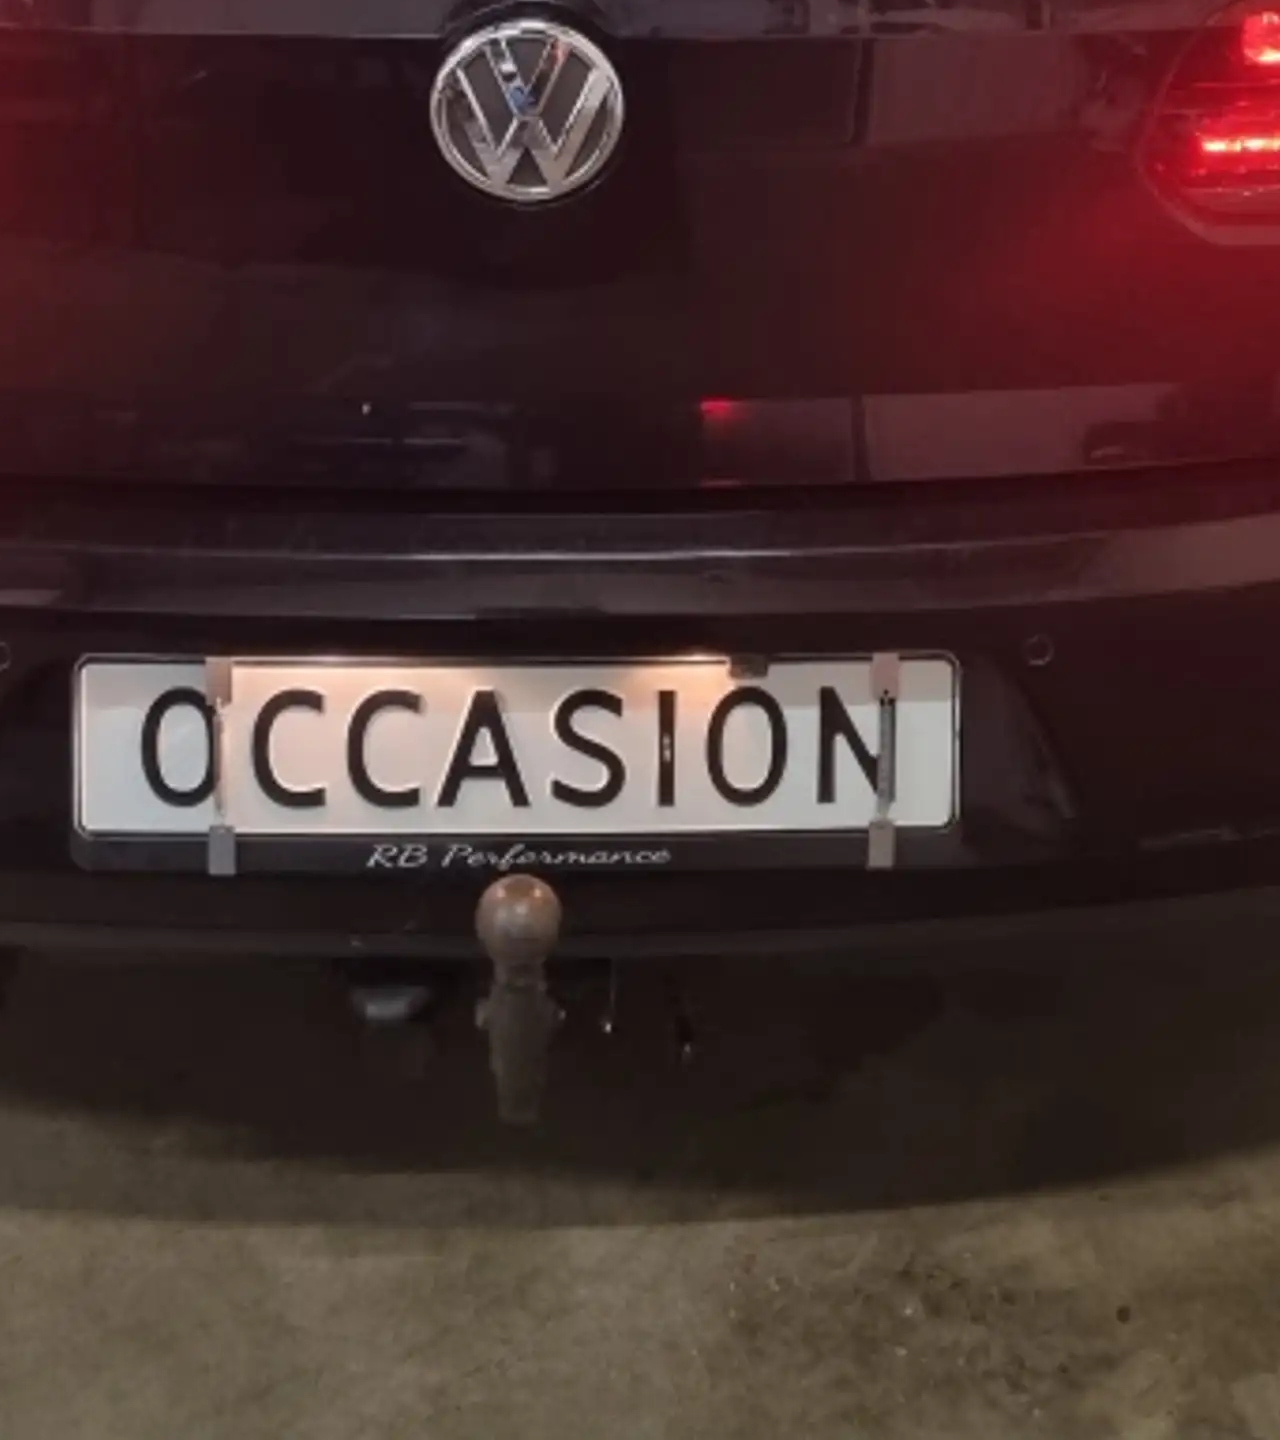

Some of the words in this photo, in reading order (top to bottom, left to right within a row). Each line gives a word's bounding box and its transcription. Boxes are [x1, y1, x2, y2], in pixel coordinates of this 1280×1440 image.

[438, 25, 619, 196] VW
[141, 686, 896, 808] OCCASION
[366, 844, 428, 868] RB
[440, 843, 671, 872] Performance
